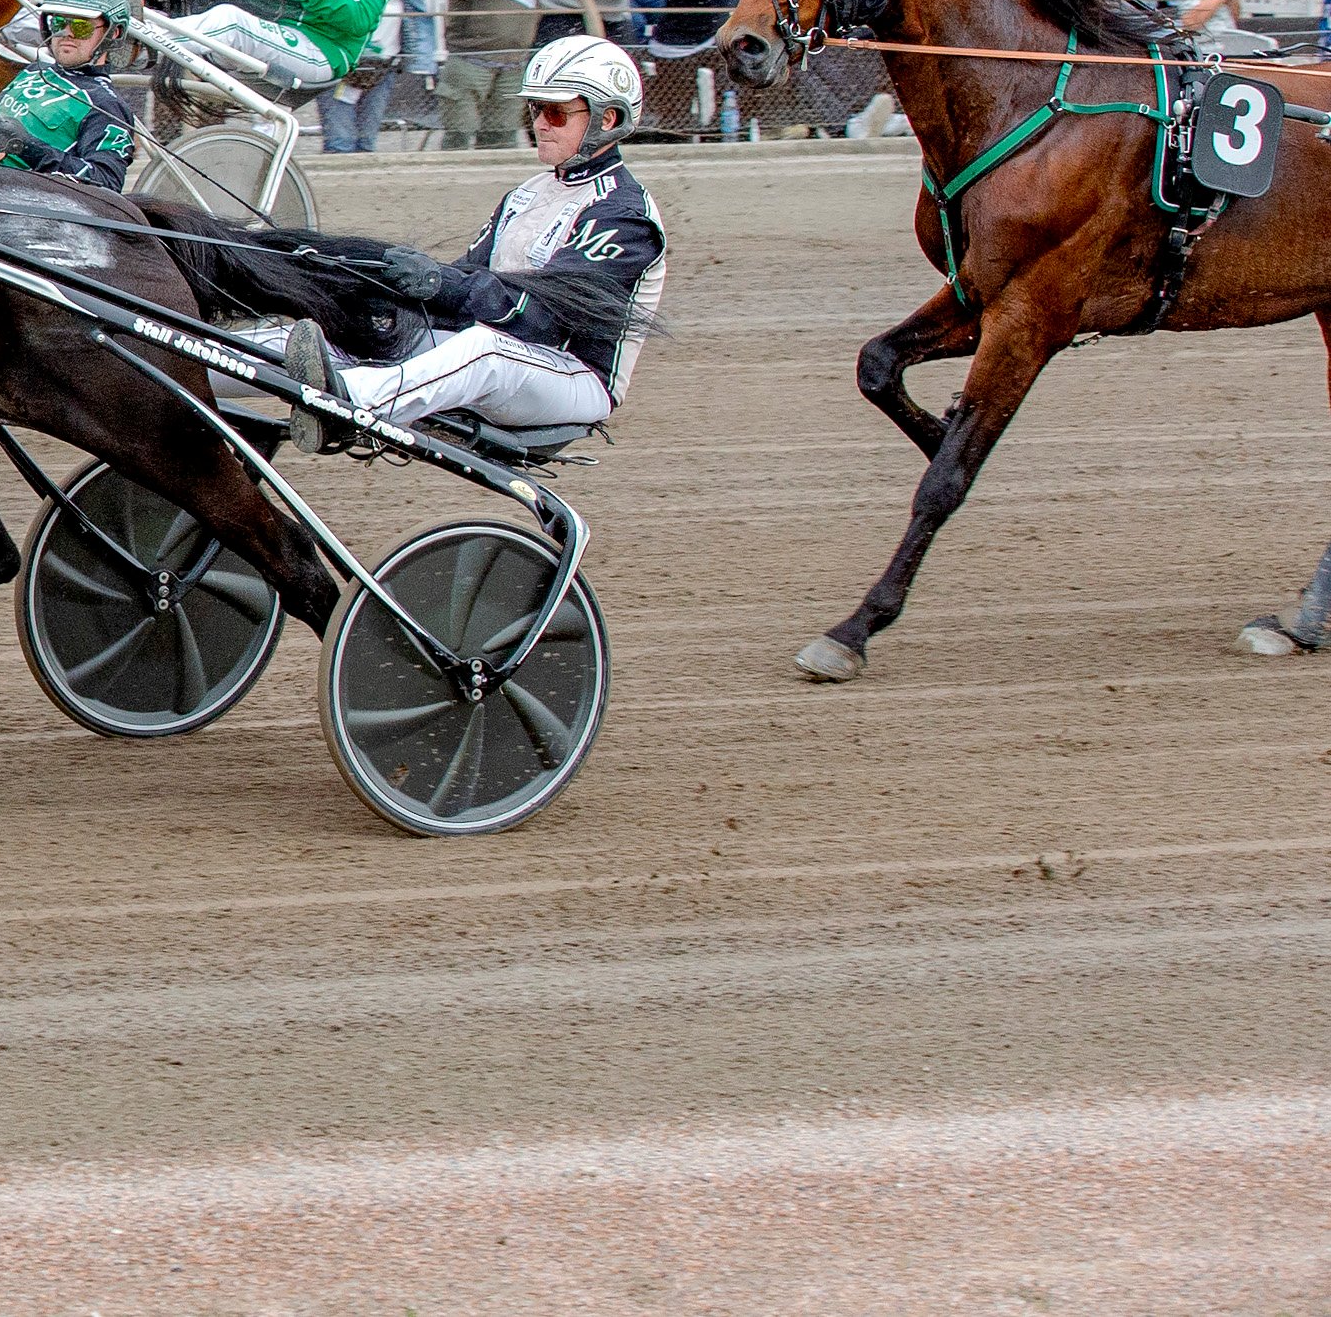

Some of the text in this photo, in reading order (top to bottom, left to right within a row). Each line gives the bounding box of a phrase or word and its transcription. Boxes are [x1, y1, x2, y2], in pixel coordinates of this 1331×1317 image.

[1213, 83, 1267, 166] 3
[133, 317, 173, 344] Stall
[353, 408, 416, 446] Chrono
